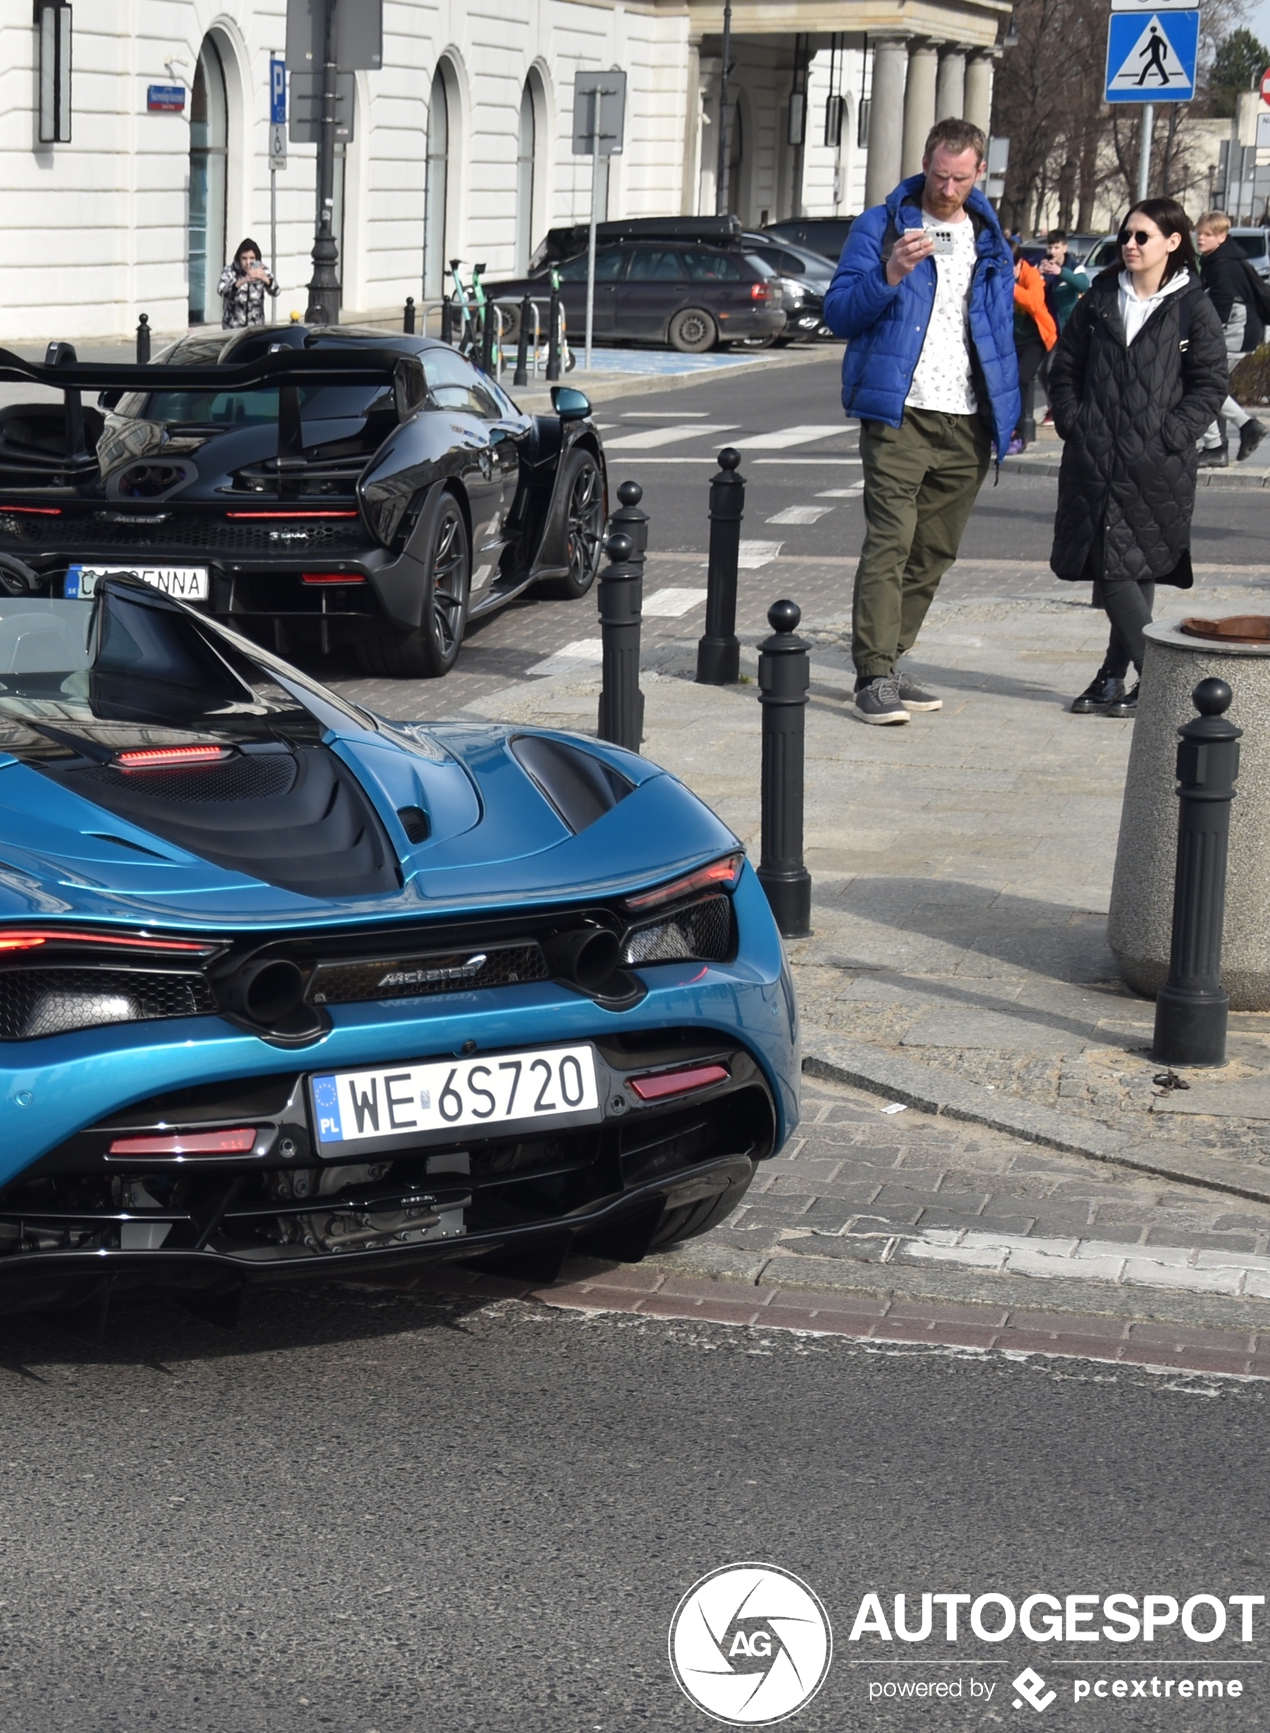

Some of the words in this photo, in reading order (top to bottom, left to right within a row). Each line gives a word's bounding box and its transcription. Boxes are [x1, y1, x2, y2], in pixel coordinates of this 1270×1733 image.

[378, 965, 477, 987] McLaren
[348, 1073, 418, 1134] WE
[438, 1055, 584, 1123] 6S720
[320, 1118, 340, 1135] PL
